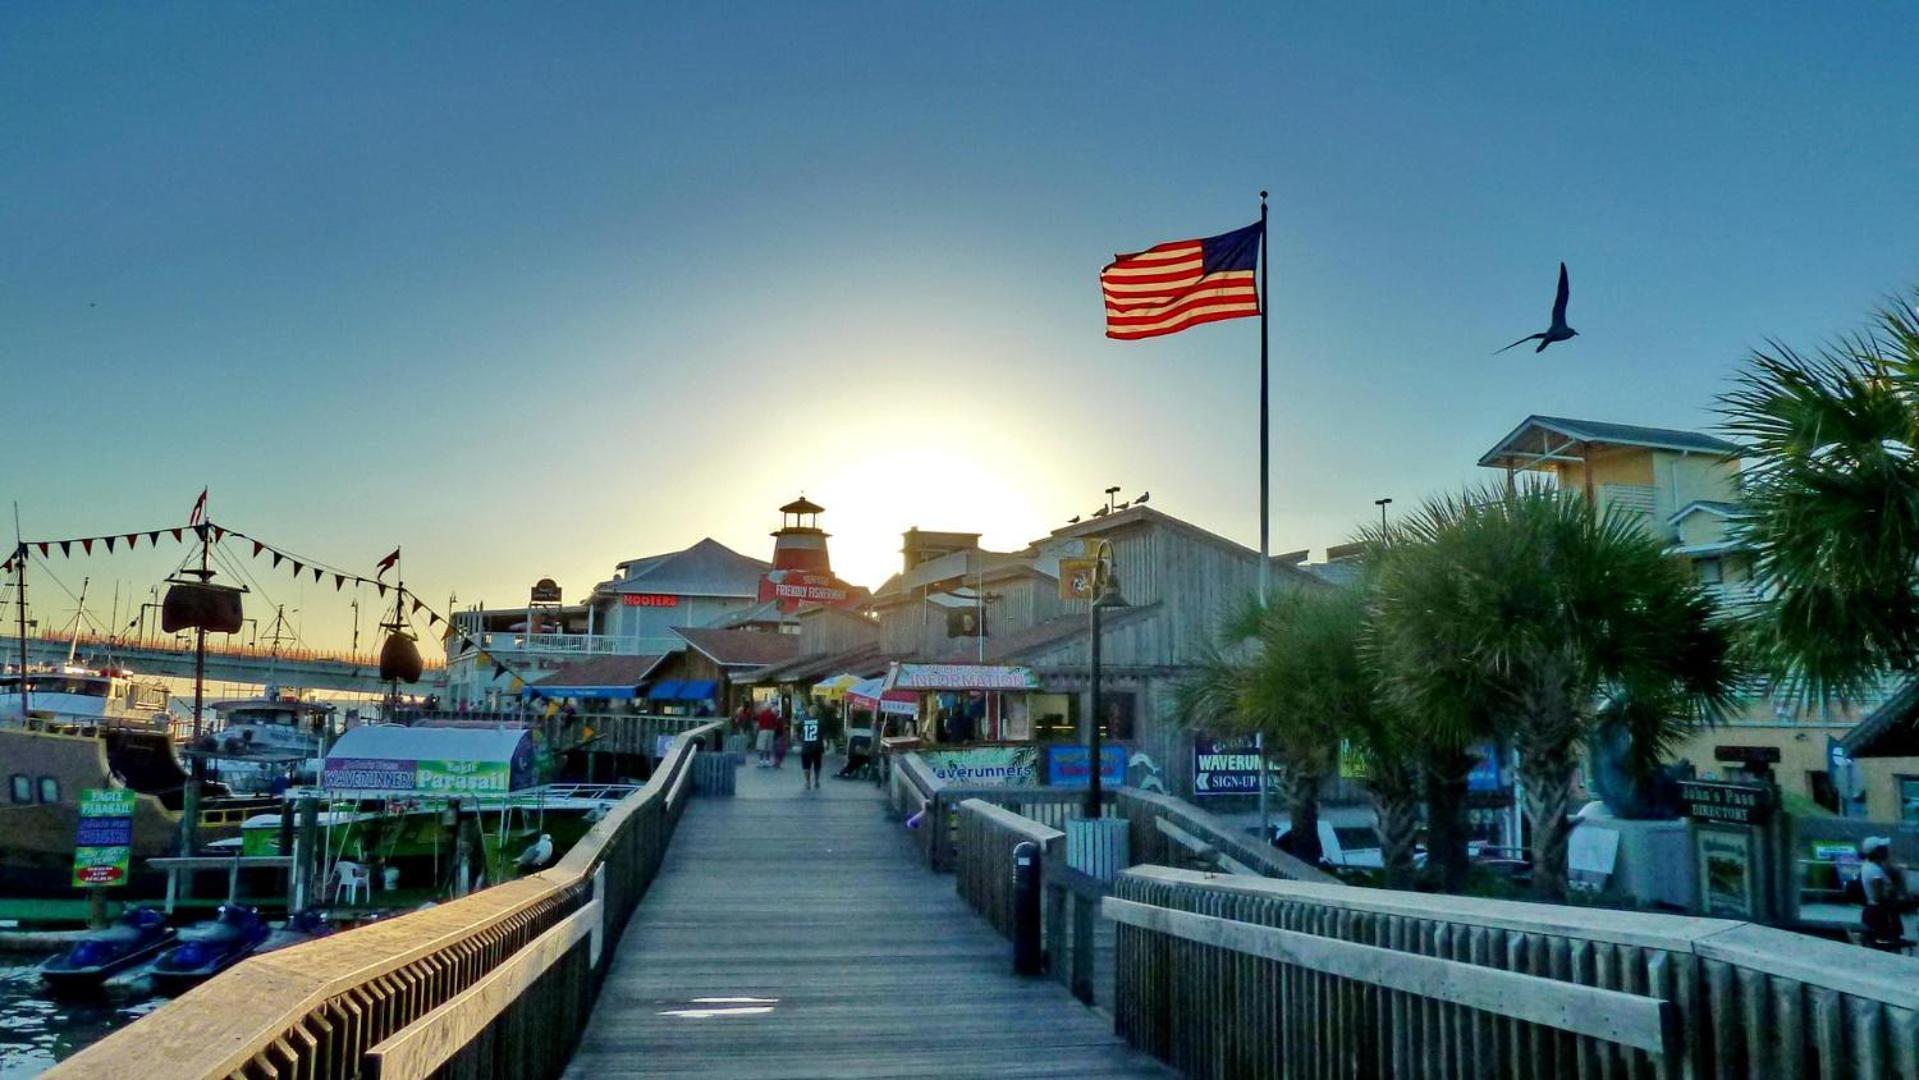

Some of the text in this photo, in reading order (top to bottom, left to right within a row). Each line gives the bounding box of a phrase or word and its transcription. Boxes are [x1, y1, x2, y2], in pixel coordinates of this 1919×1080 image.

[776, 584, 808, 598] FRIENDLY
[623, 594, 678, 607] HOOTERS
[911, 673, 1025, 687] INFORMATION
[804, 725, 818, 741] 12
[416, 769, 505, 789] Parasail
[932, 766, 1032, 779] averunners
[1212, 775, 1256, 788] SIGN-UP
[1724, 789, 1756, 807] Pass
[1692, 803, 1748, 822] DIRECTORY
